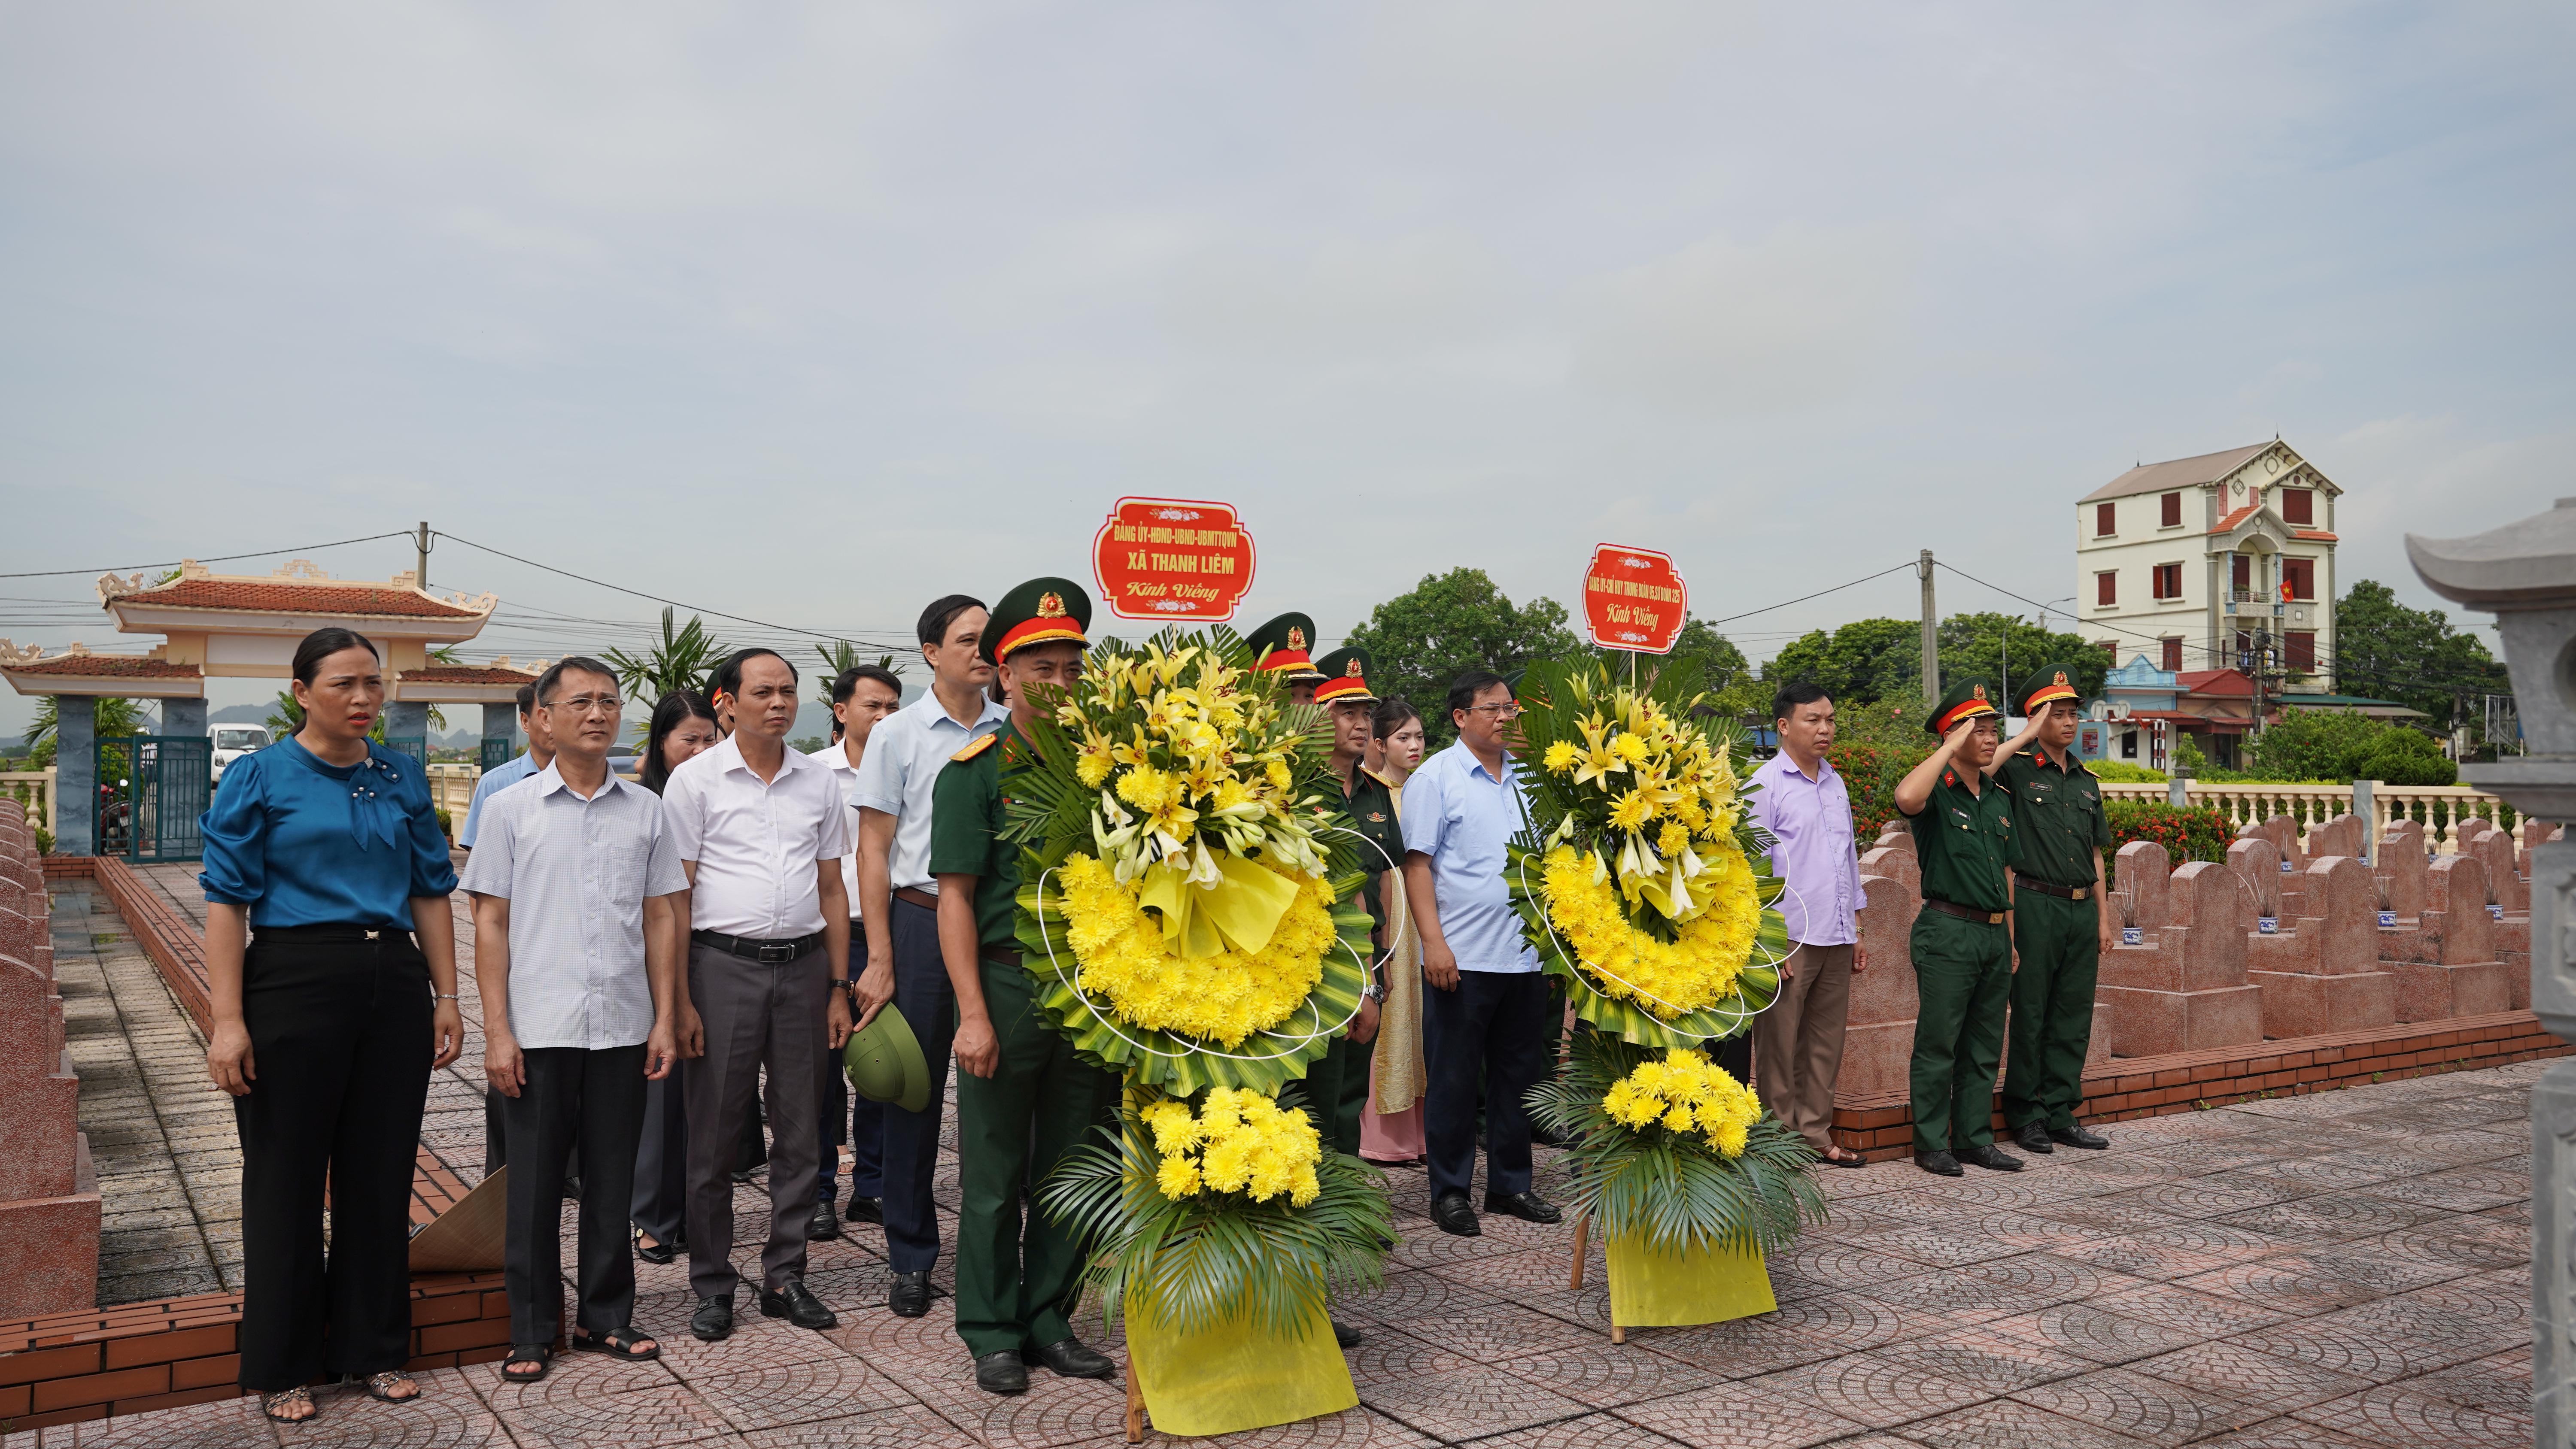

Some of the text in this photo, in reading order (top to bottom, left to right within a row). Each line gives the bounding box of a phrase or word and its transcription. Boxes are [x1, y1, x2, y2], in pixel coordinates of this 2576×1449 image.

[1114, 521, 1237, 549] ĐẢNG ỦY-HĐND-UBND-UBMTTQVN
[1127, 549, 1235, 575] XÃ THANH LIÊM
[1126, 582, 1220, 602] Kính Viếng
[1589, 571, 1599, 592] ĐẢNG
[1614, 580, 1624, 595] HUY
[1624, 581, 1638, 597] TRUNG
[1638, 581, 1649, 599] ĐOÀN
[1661, 585, 1671, 603] ĐOÀN
[1672, 589, 1680, 603] 325
[1606, 603, 1659, 632] Kính Viếng
